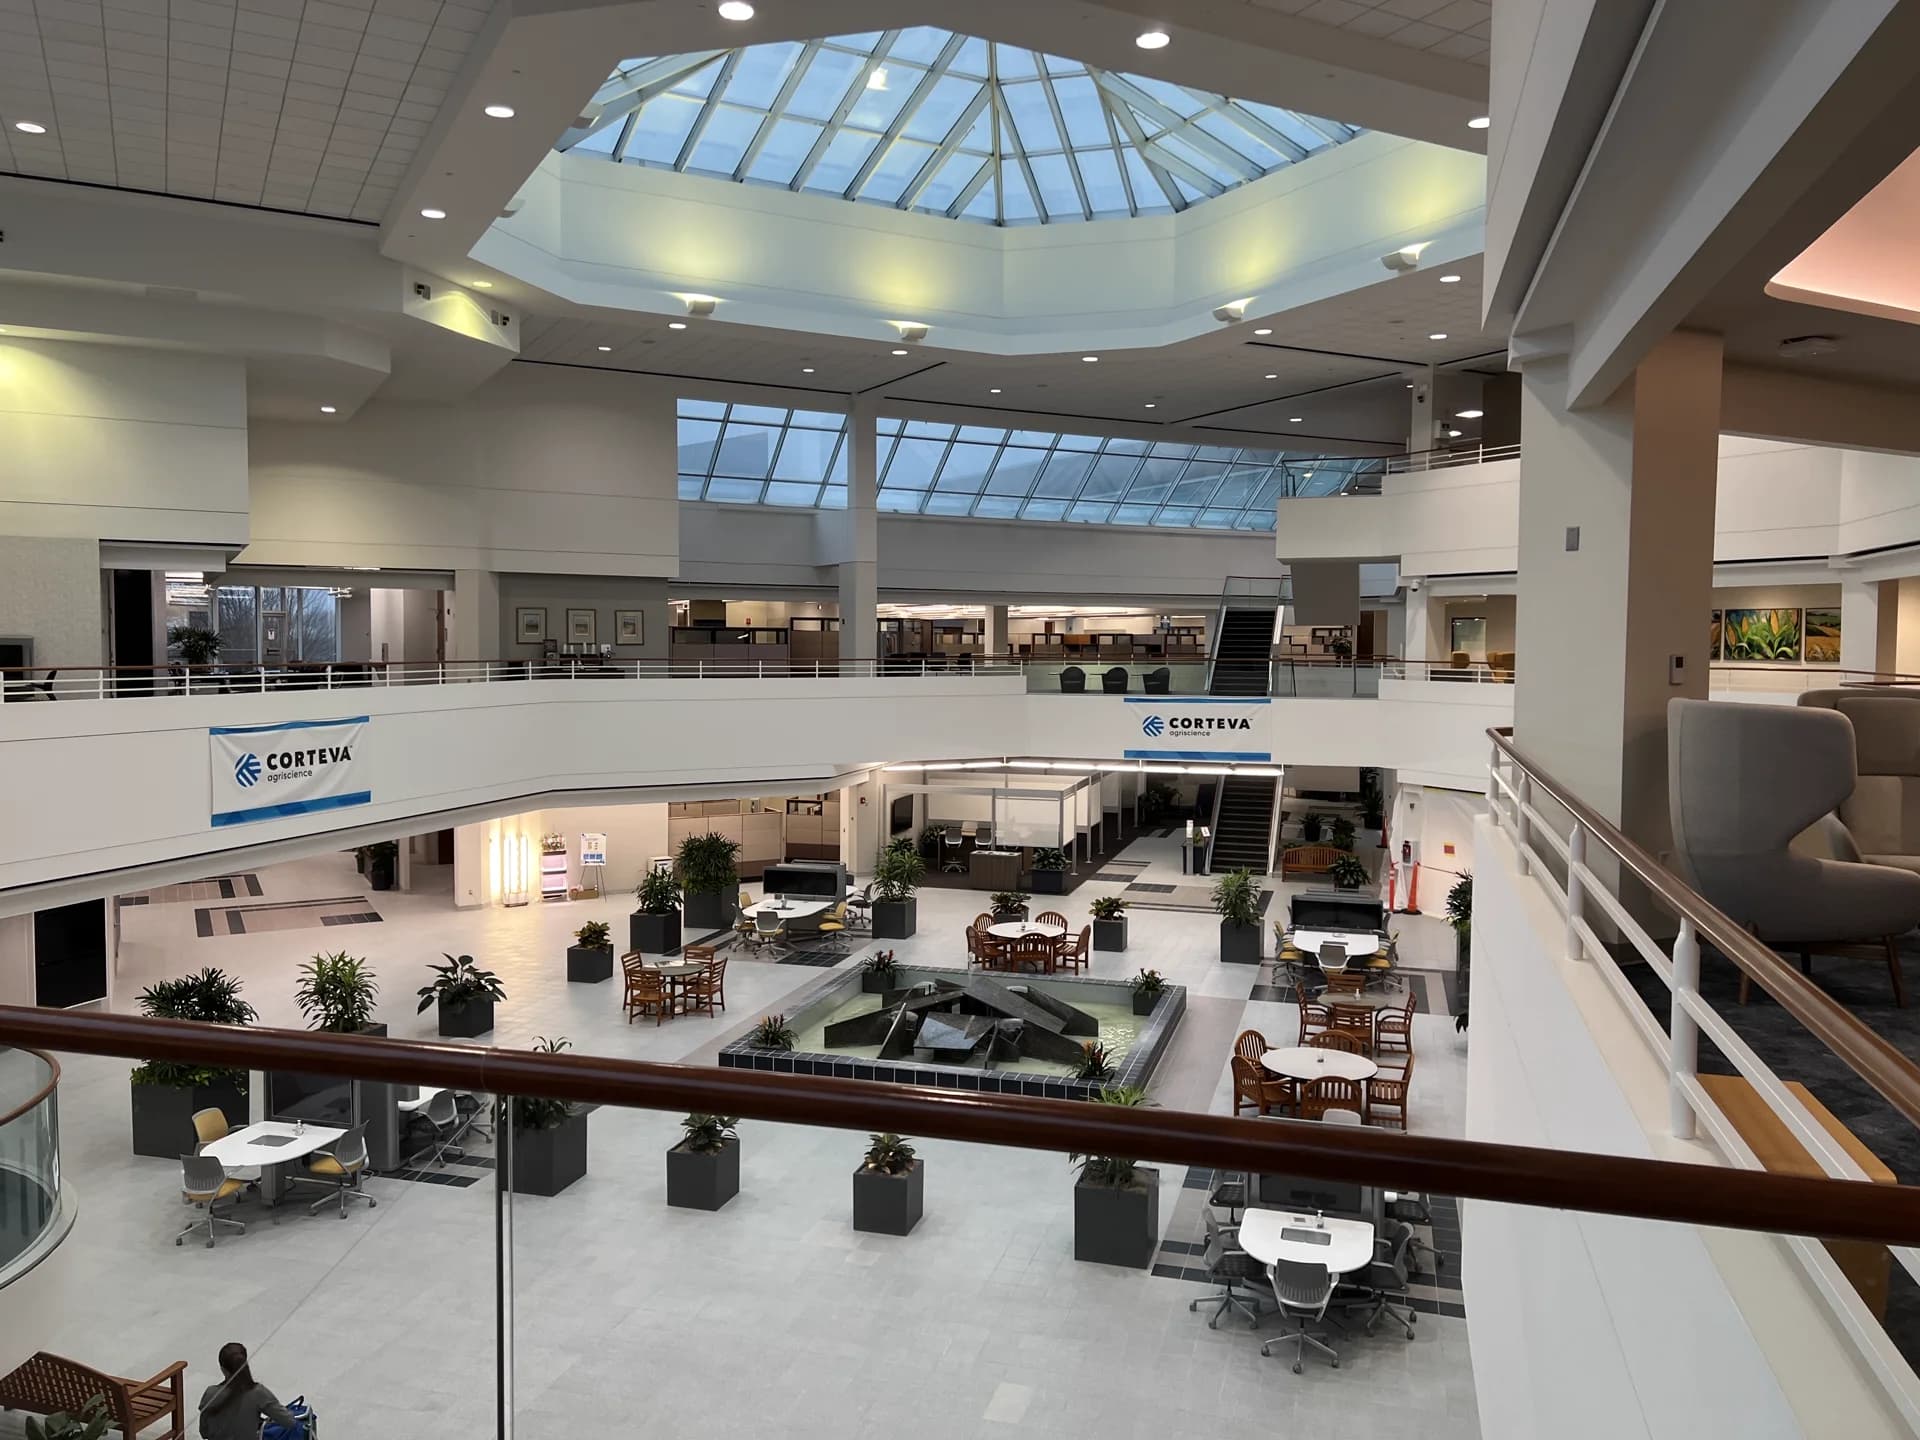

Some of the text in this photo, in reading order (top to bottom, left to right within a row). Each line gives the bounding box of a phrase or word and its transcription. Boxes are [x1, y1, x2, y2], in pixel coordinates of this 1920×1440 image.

[1169, 717, 1250, 729] CORTEVA
[266, 746, 351, 771] CORTEVA
[267, 769, 313, 783] agriscience
